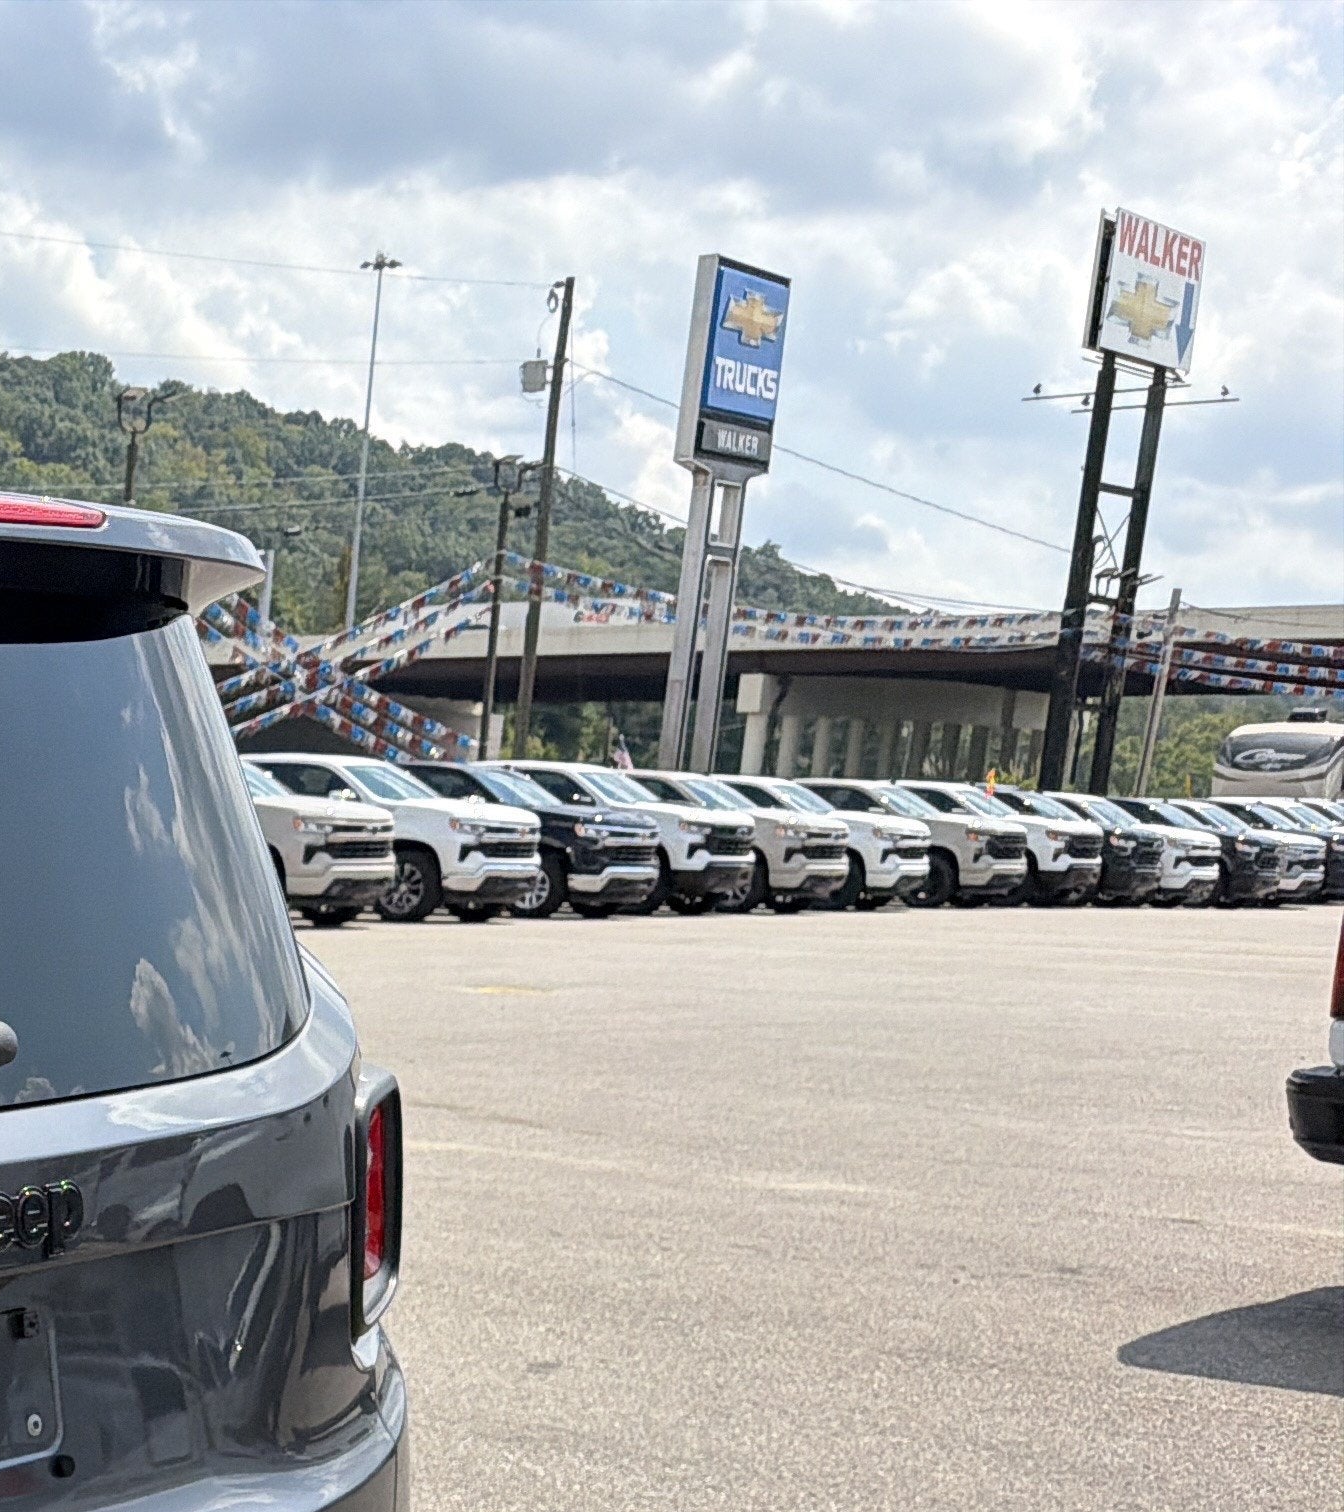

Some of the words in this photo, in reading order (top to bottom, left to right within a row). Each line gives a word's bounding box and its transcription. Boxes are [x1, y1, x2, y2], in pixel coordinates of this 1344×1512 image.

[1118, 211, 1203, 282] WALKER
[714, 355, 779, 401] TRUCKS
[717, 428, 759, 457] WALKER
